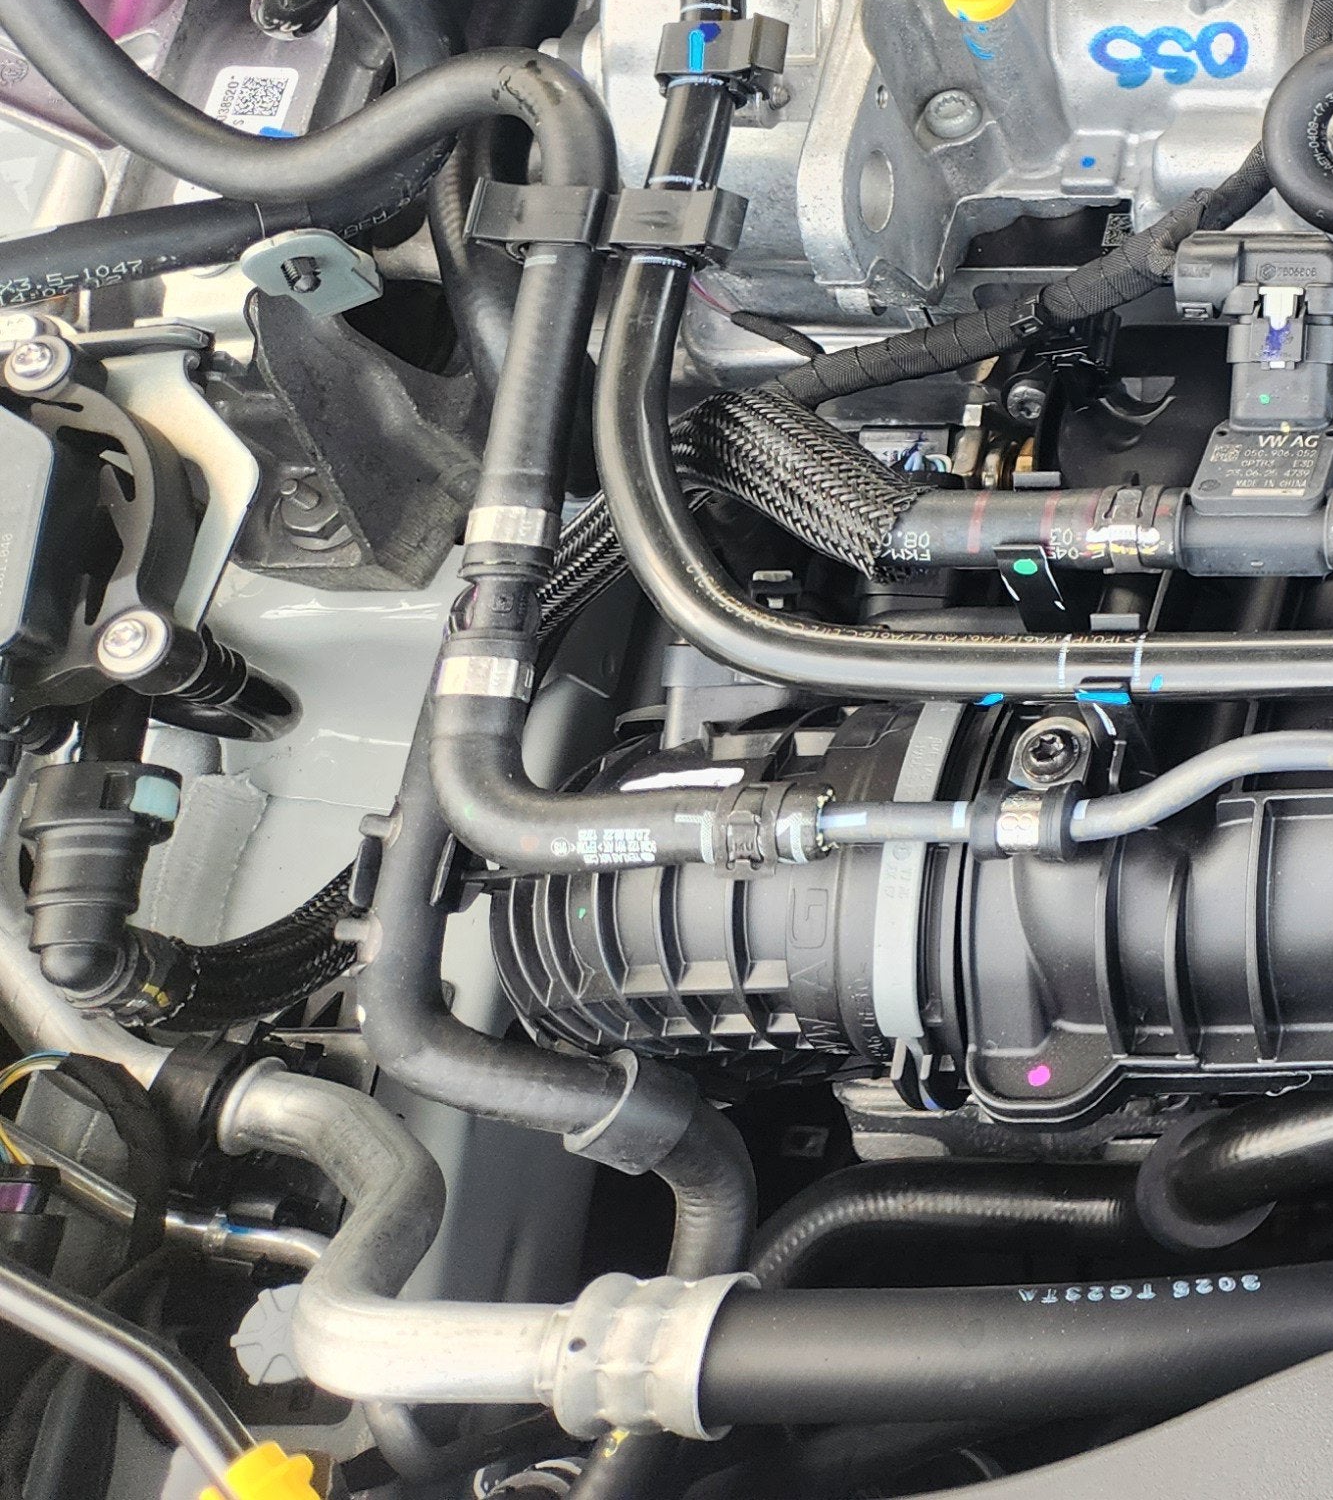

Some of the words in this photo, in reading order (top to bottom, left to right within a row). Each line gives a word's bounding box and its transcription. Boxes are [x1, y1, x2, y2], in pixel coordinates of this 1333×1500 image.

[0, 259, 144, 296] X3.5-1047
[1259, 435, 1288, 449] VW
[1290, 435, 1319, 448] AG
[1263, 479, 1275, 488] IN
[1279, 479, 1307, 488] CHINA
